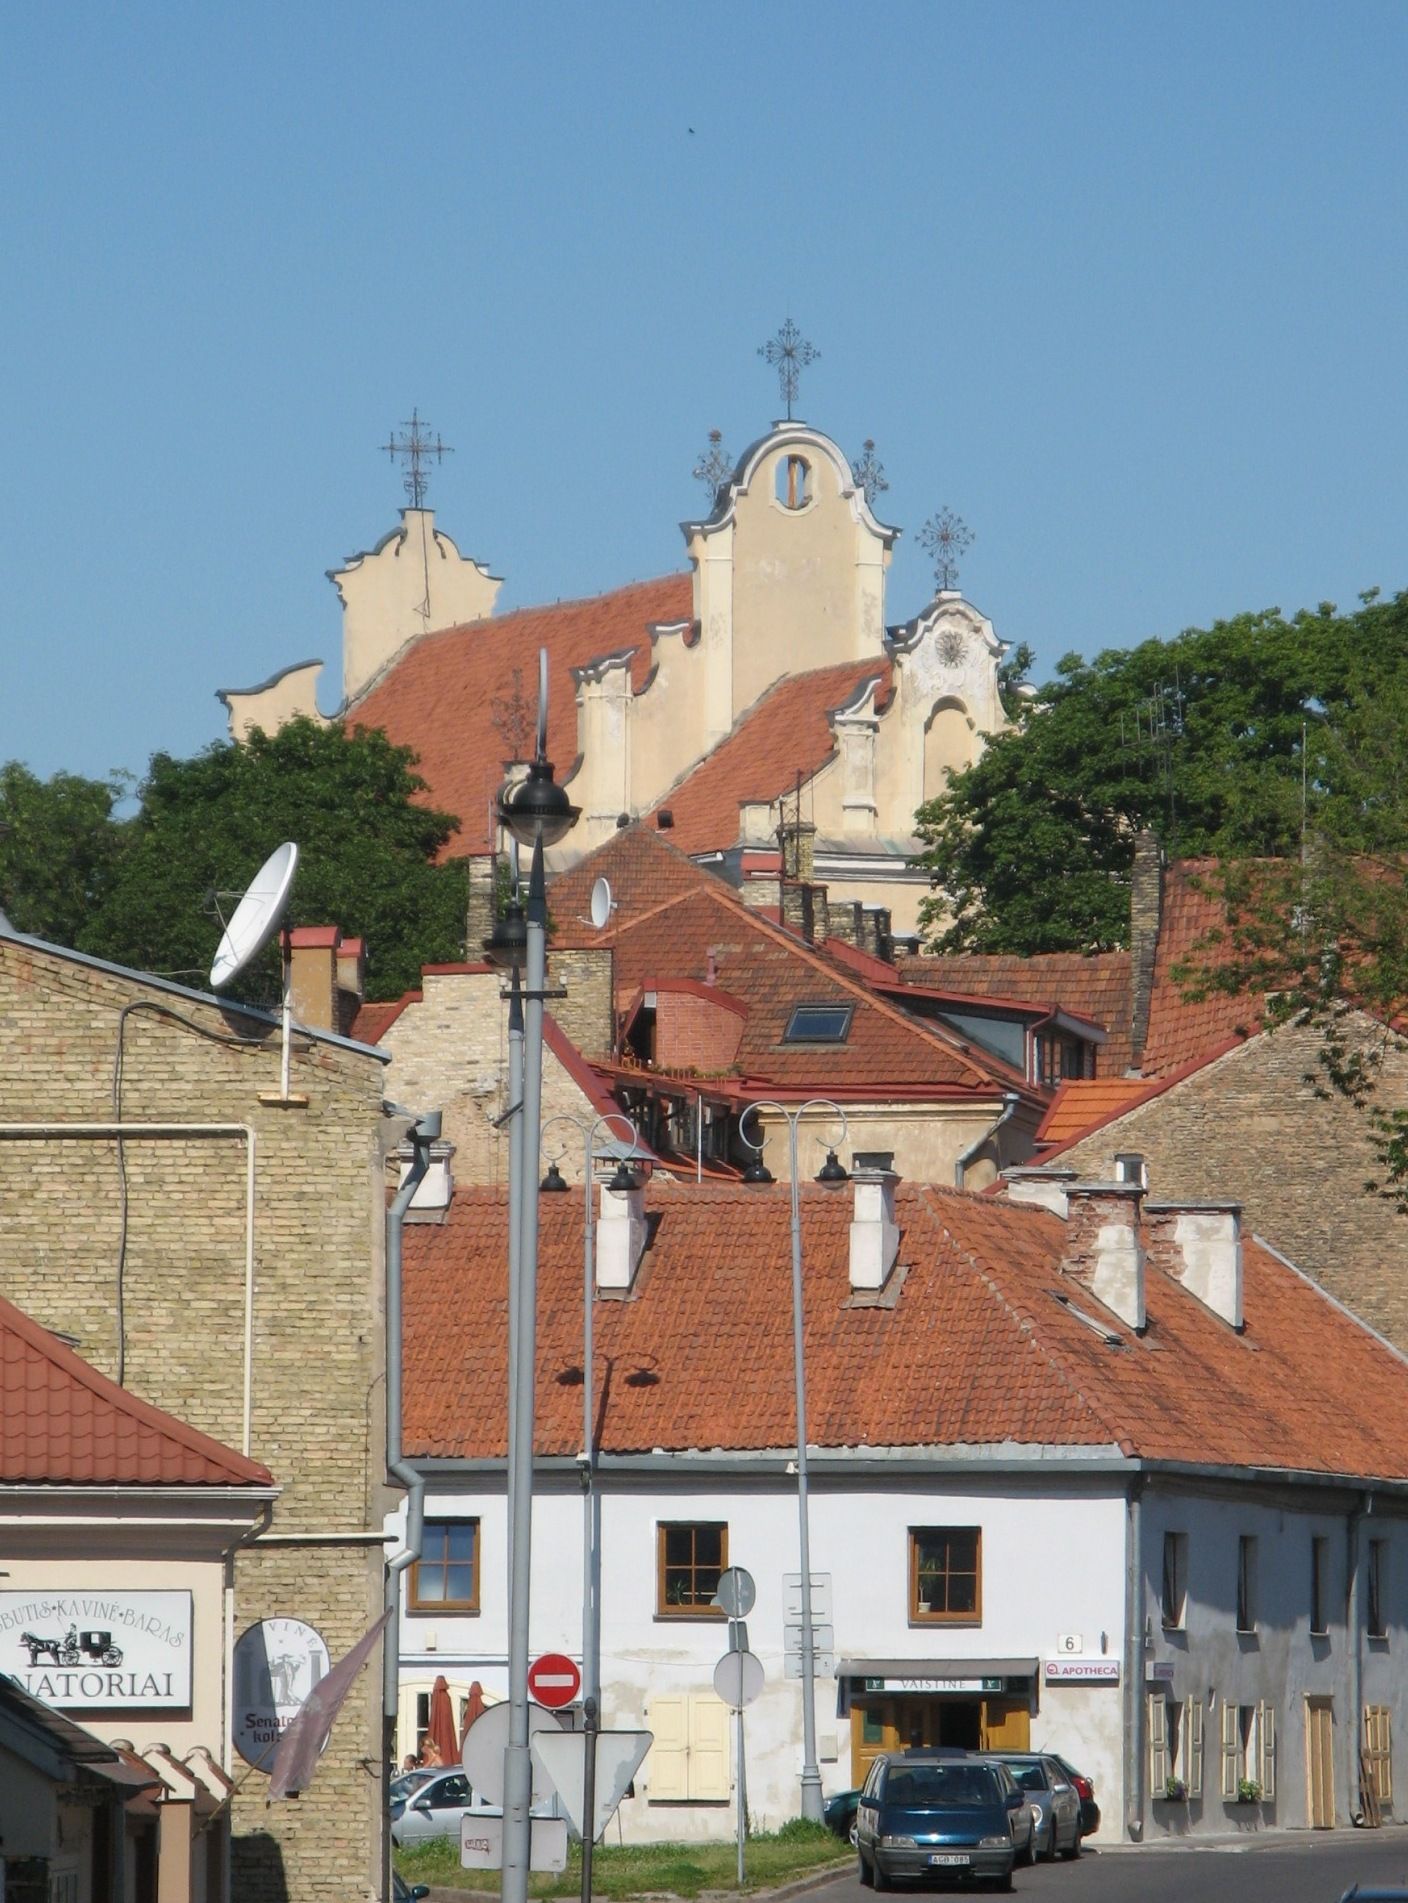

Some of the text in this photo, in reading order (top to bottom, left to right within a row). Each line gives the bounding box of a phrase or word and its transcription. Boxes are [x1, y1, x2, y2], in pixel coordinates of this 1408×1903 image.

[122, 1608, 185, 1648] BARAS
[1065, 1636, 1075, 1650] 6
[1062, 1667, 1118, 1675] APOTHECA
